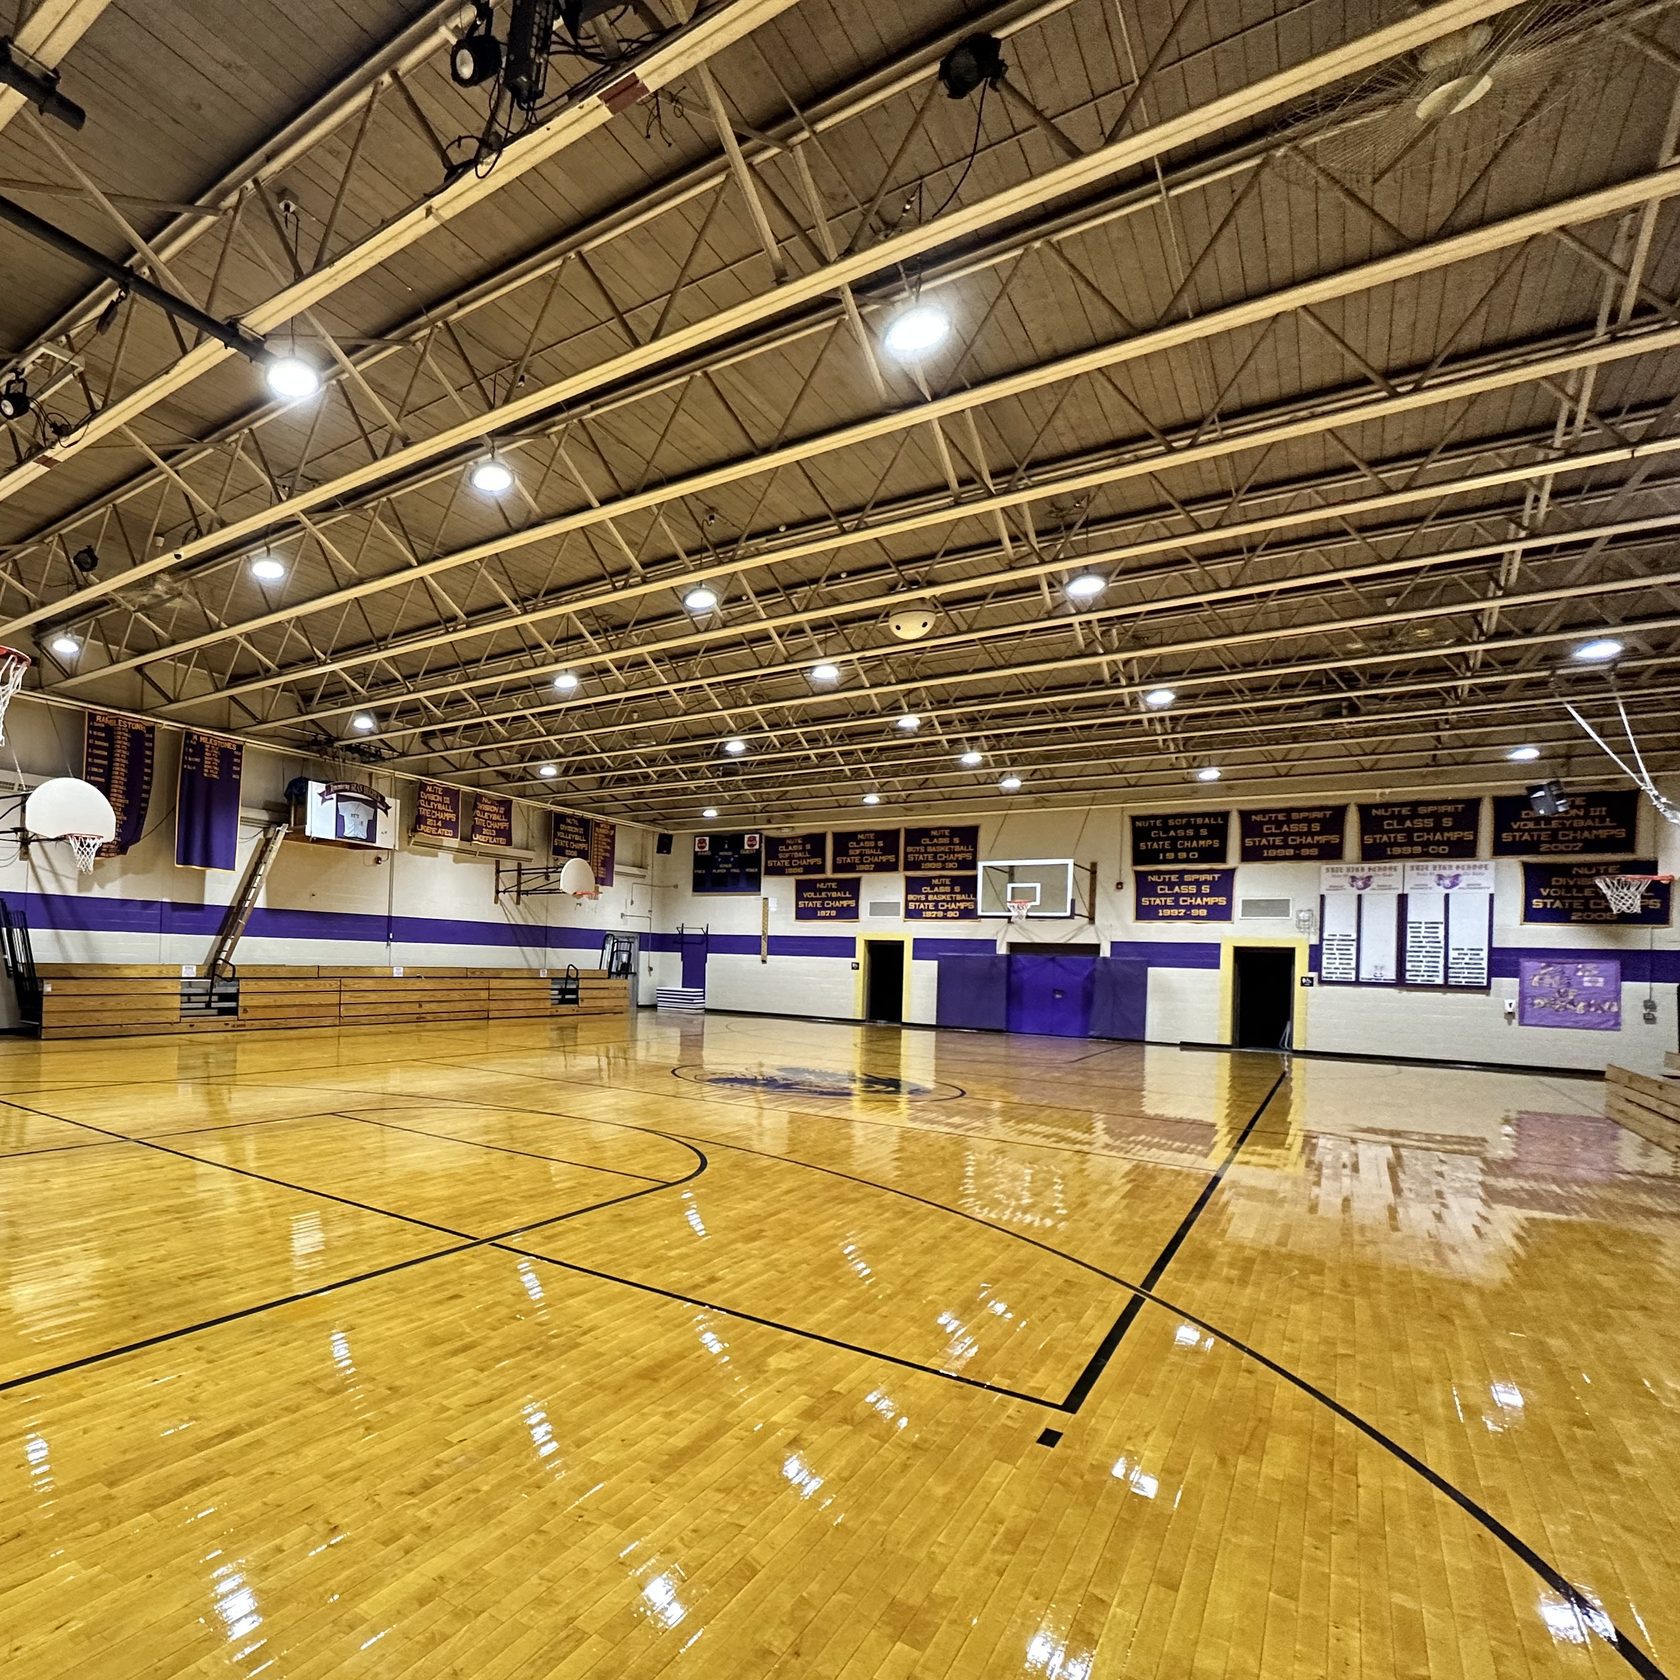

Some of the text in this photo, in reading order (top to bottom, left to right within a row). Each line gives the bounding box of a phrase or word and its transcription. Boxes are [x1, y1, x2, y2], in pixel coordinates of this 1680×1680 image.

[426, 785, 443, 795] NUTE
[418, 800, 454, 812] OLLEYBALL
[1371, 804, 1466, 816] NUTE SPIRIT
[1251, 811, 1333, 822] NUTE SPIRIT
[1168, 817, 1224, 826] SOFTBALL
[1383, 817, 1453, 829] CLASS S
[1511, 818, 1617, 829] VOLLEYBALL
[1263, 823, 1320, 833] CLASS S
[1151, 829, 1194, 838] CLASS
[1364, 831, 1474, 844] STATE CHAMPS
[1501, 829, 1626, 842] STATE CHAMPS
[1139, 839, 1220, 850] STATE CHAMPS
[1244, 835, 1340, 846] STATE CHAMPS
[1539, 843, 1584, 852] 2007
[778, 851, 811, 859] SOFTBALL
[836, 855, 896, 864] STATE CHAMPS
[907, 853, 973, 862] STATE CHAMPS
[791, 858, 822, 866] CHAMPS
[1572, 866, 1622, 874] NUTE
[1184, 874, 1221, 882] SPIRIT
[1157, 885, 1210, 893] CLASS S
[928, 893, 976, 901] BASKETBALL
[1141, 897, 1227, 906] STATE CHAMPS
[908, 901, 975, 910] STATE CHAMPS
[1532, 899, 1661, 909] STATE CHPS
